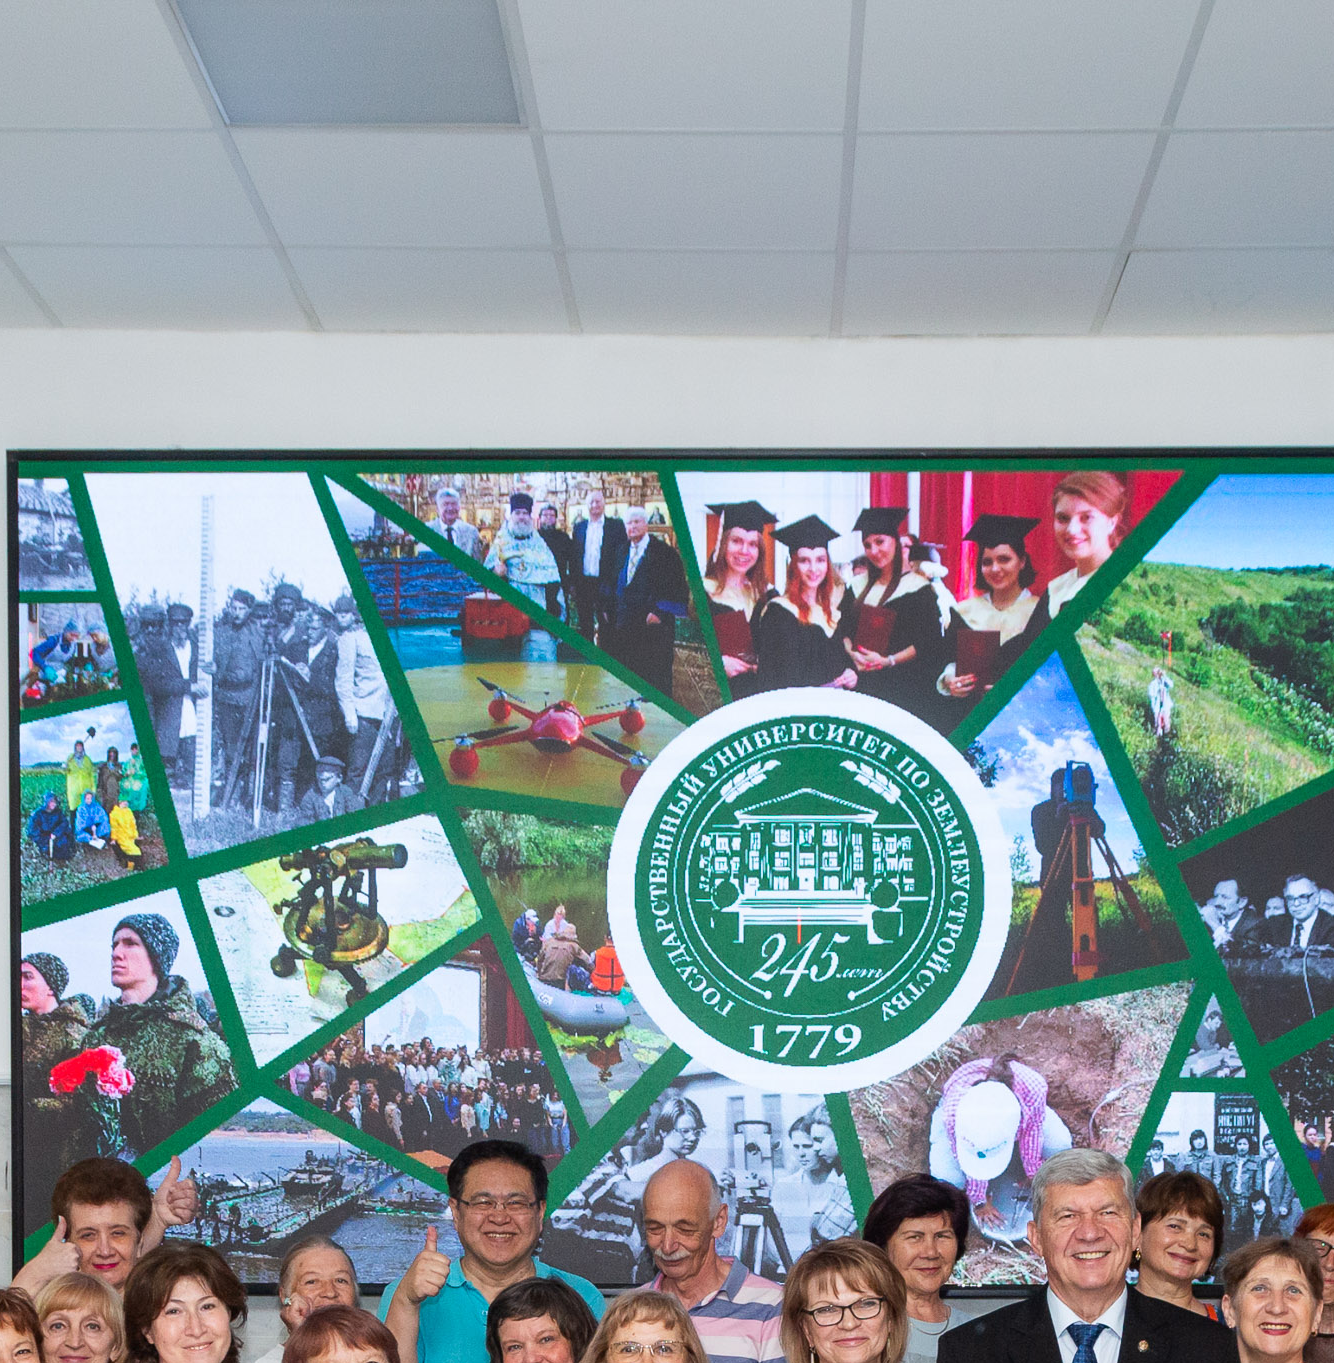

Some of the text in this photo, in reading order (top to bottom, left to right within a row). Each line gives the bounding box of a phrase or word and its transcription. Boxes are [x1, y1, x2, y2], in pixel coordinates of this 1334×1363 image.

[649, 722, 970, 1022] ГОСУДАРСТВЕННЫЙ УНИВЕРСИТЕТ ПО ЗЕМЛЕУСТРОЙСТВУ
[749, 932, 850, 997] 245
[748, 1023, 862, 1059] 1779
